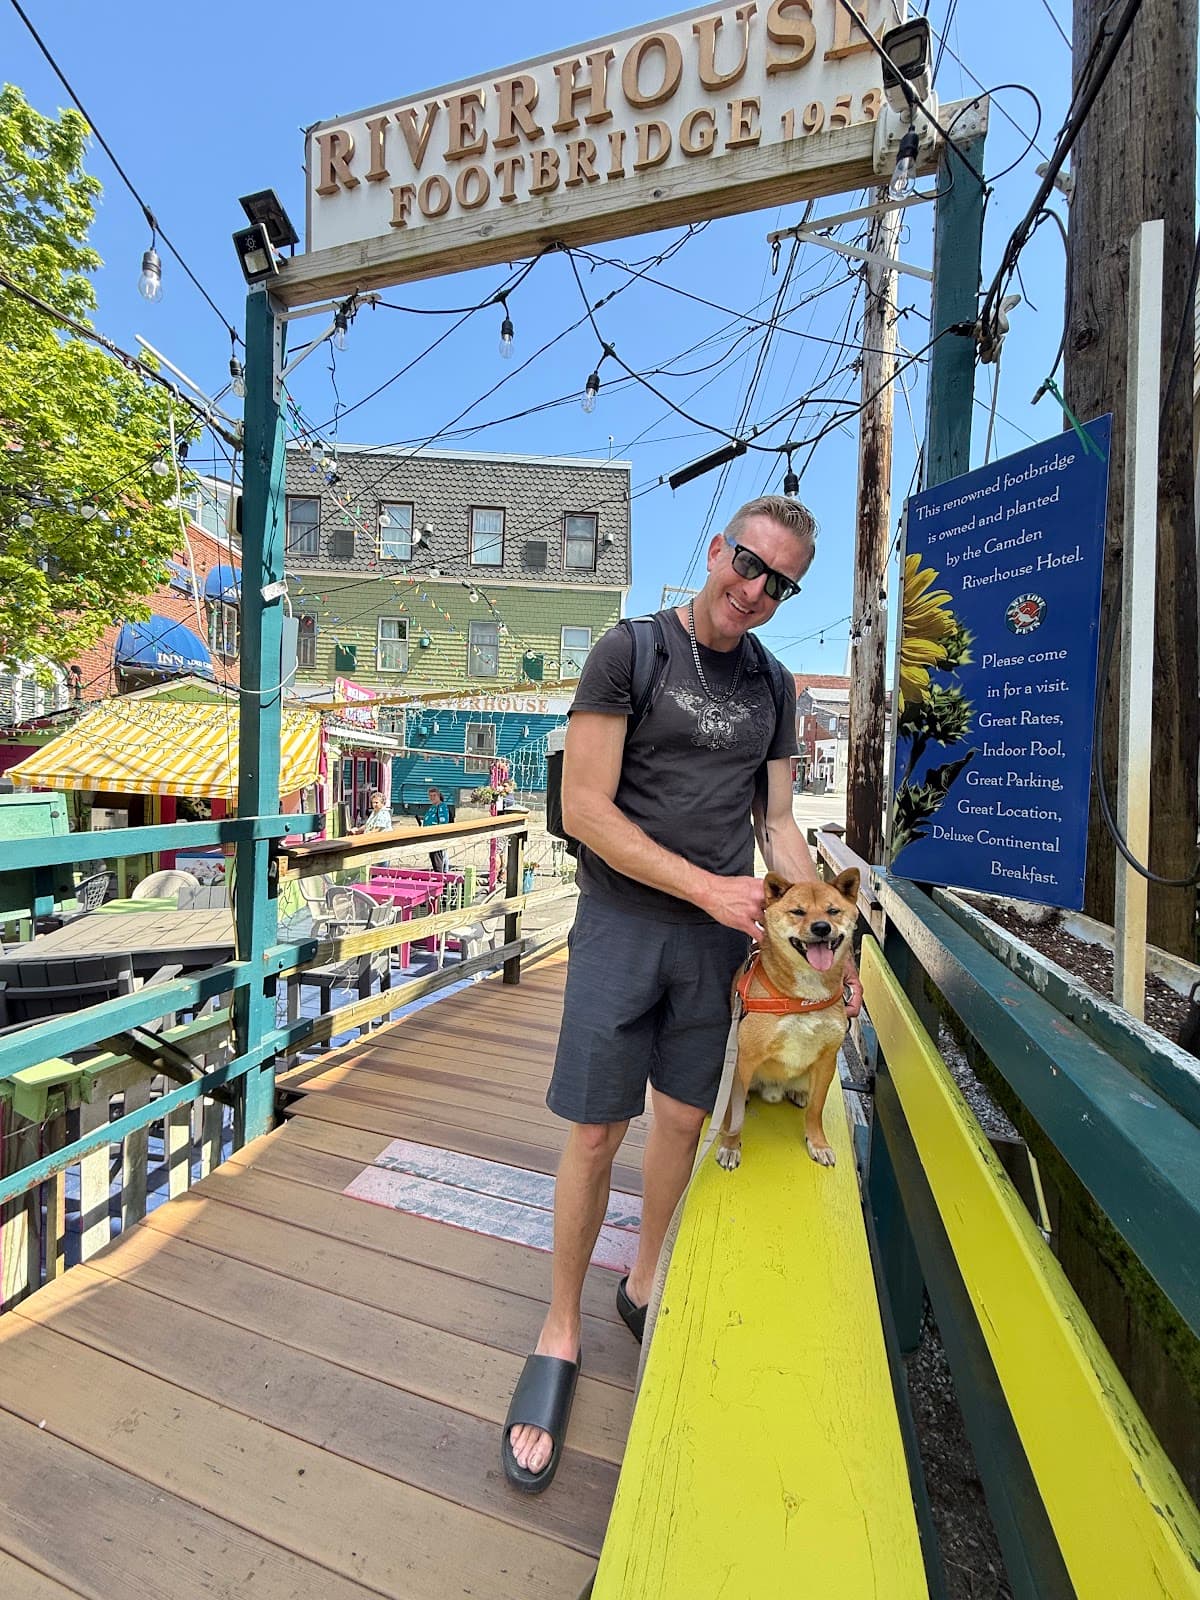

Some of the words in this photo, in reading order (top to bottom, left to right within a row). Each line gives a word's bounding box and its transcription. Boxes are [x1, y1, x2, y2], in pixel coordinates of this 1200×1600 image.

[315, 0, 886, 196] RIVERHOUSE
[389, 97, 762, 228] FOOTBRIDGE
[781, 87, 882, 139] 1953
[916, 504, 941, 521] This
[943, 476, 1002, 513] renowned
[1003, 453, 1075, 493] footbridge
[927, 532, 937, 544] is
[938, 515, 976, 541] owned
[978, 506, 1003, 527] and
[1006, 485, 1060, 521] planted
[946, 551, 961, 568] by
[962, 545, 982, 561] the
[984, 528, 1043, 554] Camden
[962, 567, 1033, 590] Riverhouse
[1036, 545, 1084, 572] Hotel.
[1026, 593, 1047, 607] LOVE
[1015, 622, 1041, 635] PETS
[157, 652, 184, 665] INN
[982, 653, 1025, 669] Please
[1027, 650, 1068, 663] come
[987, 685, 1000, 698] in
[1003, 681, 1022, 699] for
[1024, 685, 1032, 695] a
[1035, 678, 1069, 693] visit.
[978, 712, 1017, 728] Great
[1020, 710, 1064, 726] Rates,
[983, 741, 1028, 757] Indoor
[1030, 740, 1066, 758] Pool,
[966, 770, 1004, 786] Great
[1006, 771, 1064, 792] Parking,
[957, 799, 994, 816] Great
[996, 801, 1062, 823] Location,
[932, 825, 975, 843] Deluxe
[976, 829, 1060, 853] Continental
[990, 860, 1058, 885] Breakfast.
